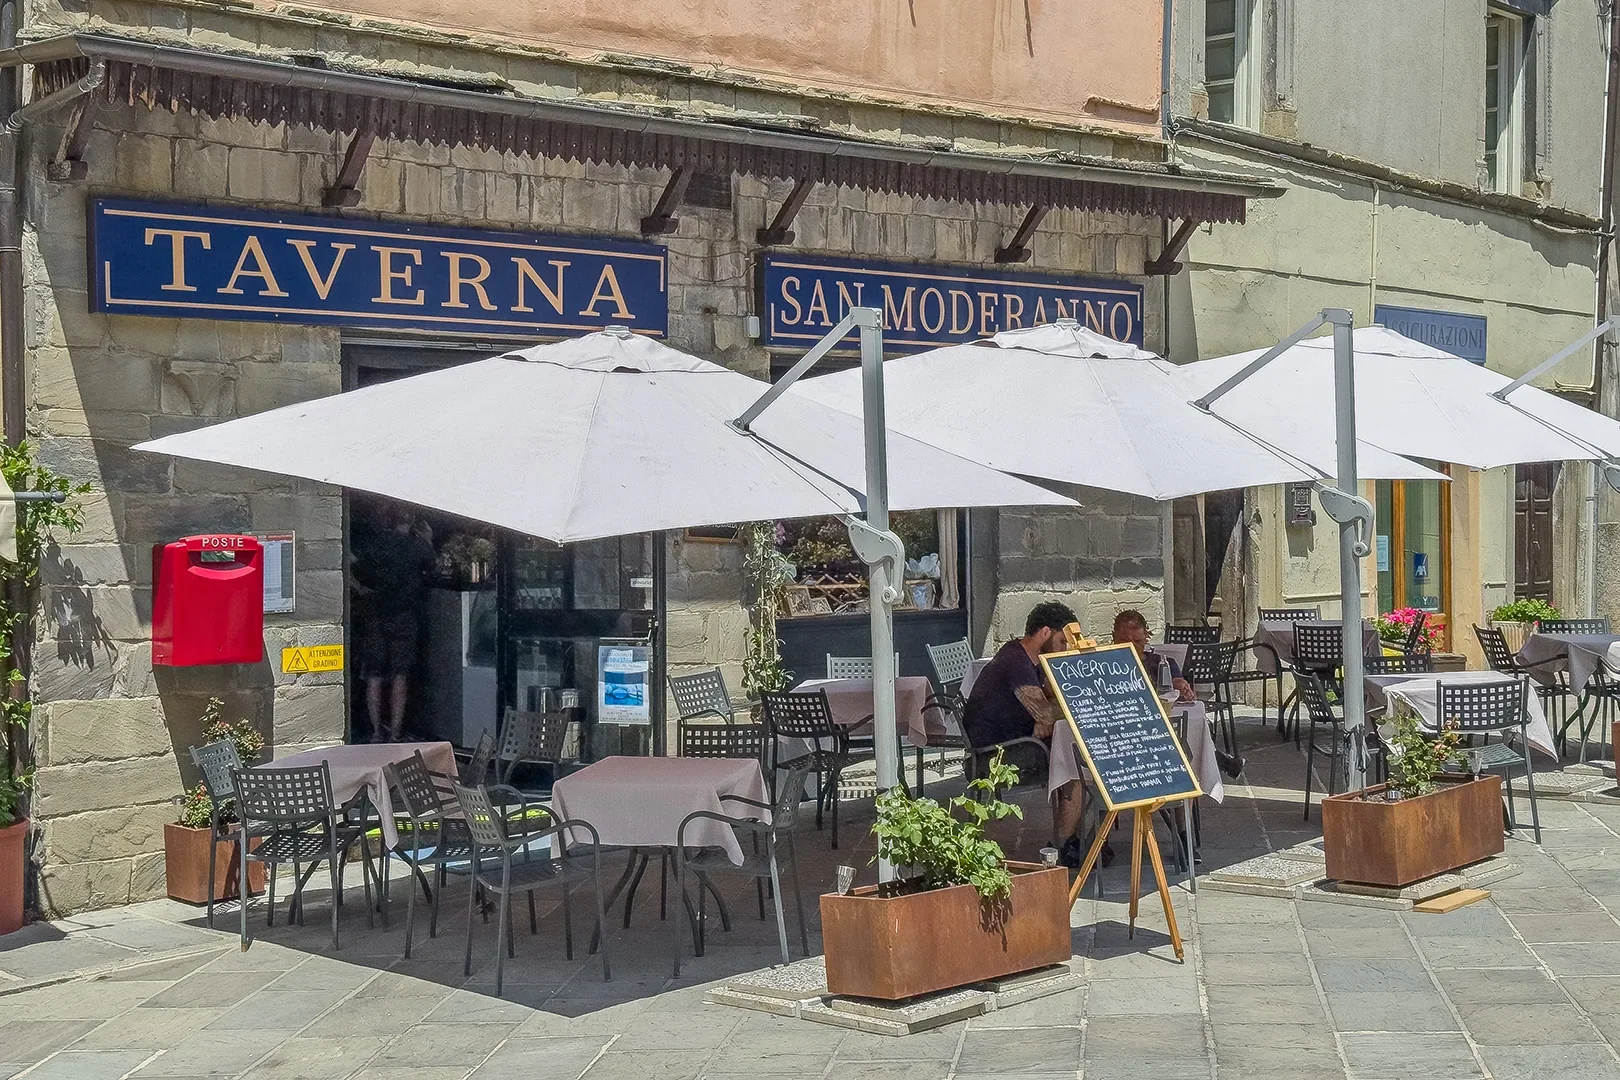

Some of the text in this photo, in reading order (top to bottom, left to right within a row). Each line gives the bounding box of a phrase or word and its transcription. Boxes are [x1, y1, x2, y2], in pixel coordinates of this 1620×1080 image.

[144, 227, 636, 320] TAVERNA
[781, 276, 1133, 344] SAN MODERANNO
[202, 537, 244, 548] POSTE
[309, 648, 342, 658] ATTENZIONE
[313, 659, 338, 668] GRADINO
